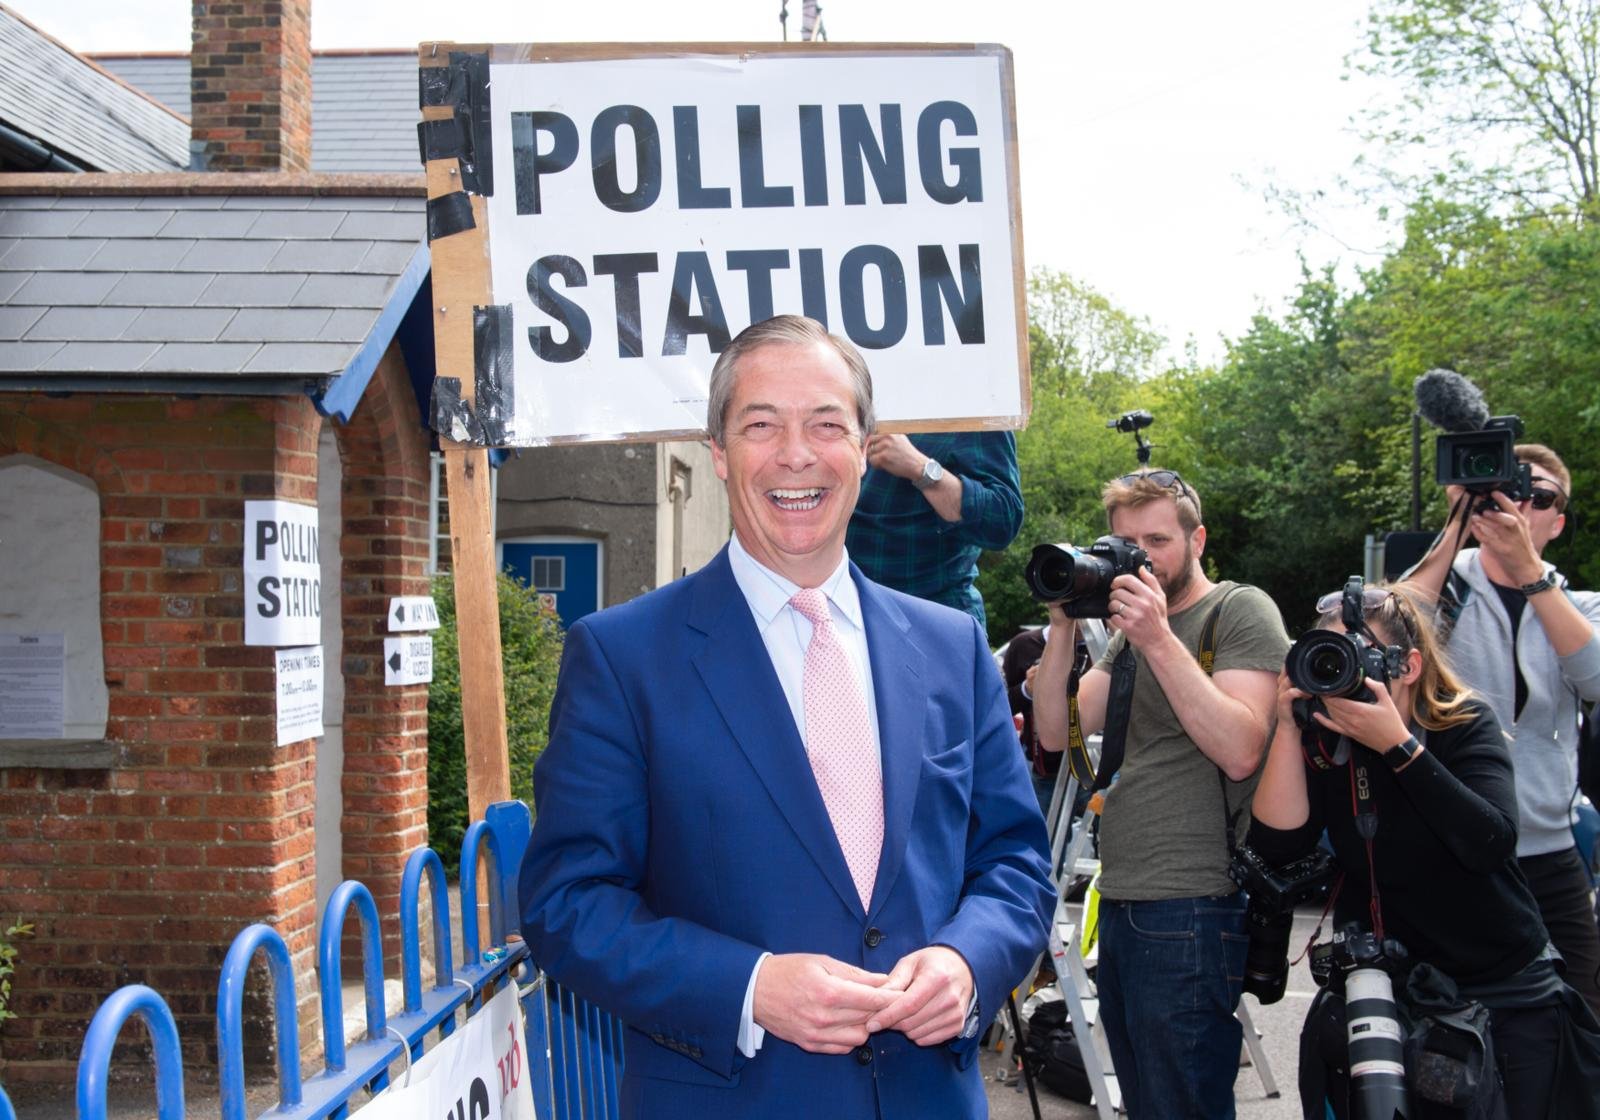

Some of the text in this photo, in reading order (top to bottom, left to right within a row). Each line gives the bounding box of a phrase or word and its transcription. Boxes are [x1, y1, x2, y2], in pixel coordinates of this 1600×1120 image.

[511, 100, 983, 215] POLLING
[526, 243, 986, 363] STATION
[1356, 766, 1370, 800] EOS
